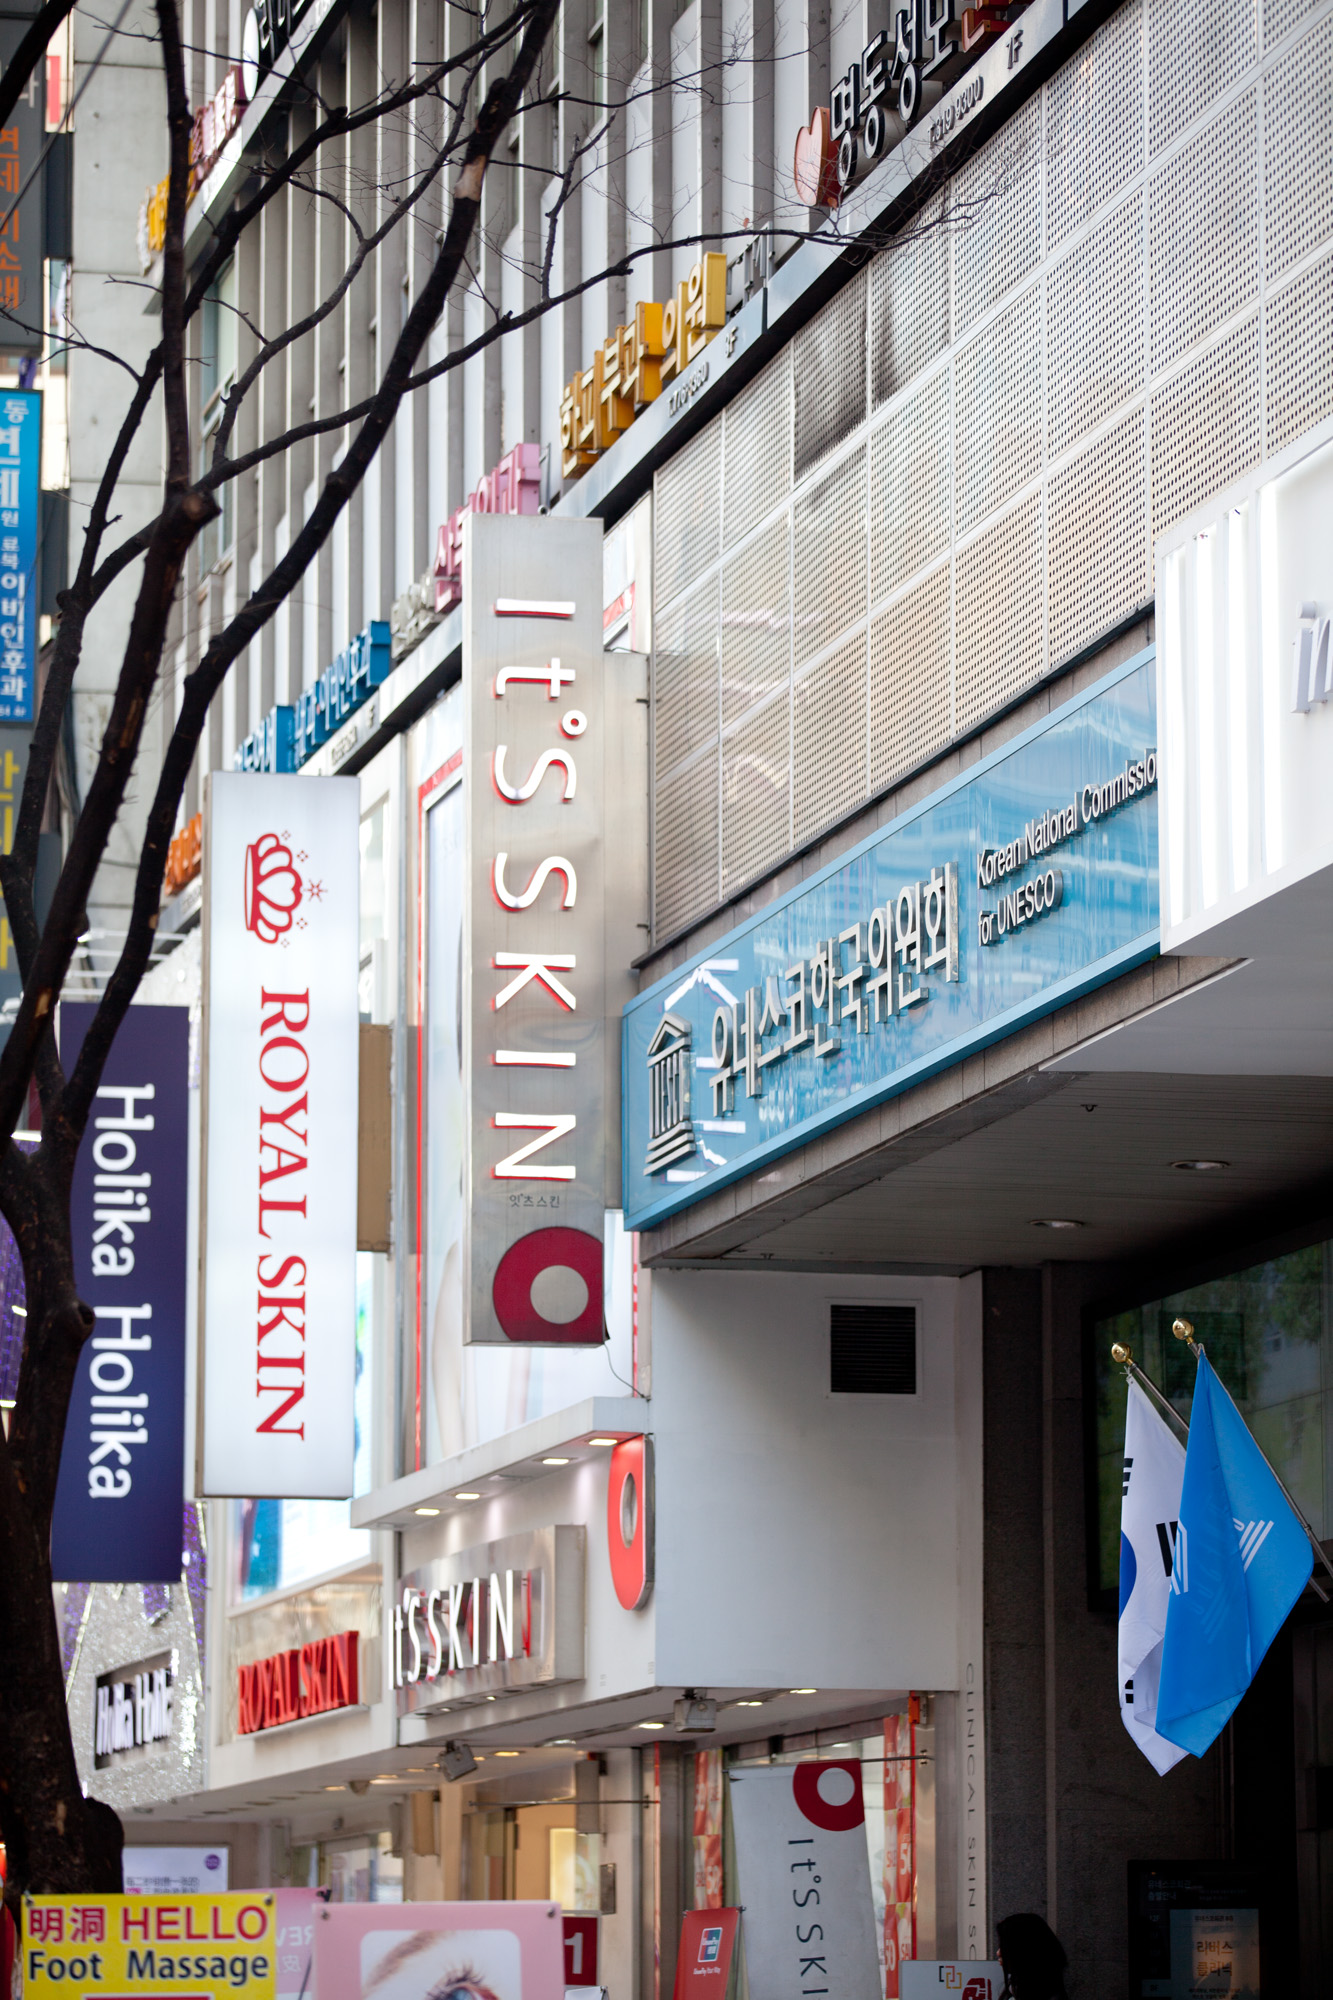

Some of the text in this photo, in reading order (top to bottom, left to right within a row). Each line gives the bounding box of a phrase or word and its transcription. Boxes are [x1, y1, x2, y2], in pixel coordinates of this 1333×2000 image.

[1006, 29, 1024, 69] 1F
[955, 76, 984, 120] 9300
[977, 748, 1158, 890] Korean National Commissio
[978, 869, 1060, 947] for UNESCO
[709, 862, 959, 1118] 유네스코한국위원회
[256, 985, 311, 1441] ROYAL SKIN
[88, 1084, 156, 1499] Holika Holika
[237, 1630, 359, 1735] ROYAL SKIN
[966, 1662, 977, 1821] CLINICAL
[967, 1836, 977, 1908] SKIN
[27, 1905, 269, 1943] 明洞 HELLO
[796, 1923, 829, 2000] SKI
[28, 1949, 269, 1987] Foot Massage
